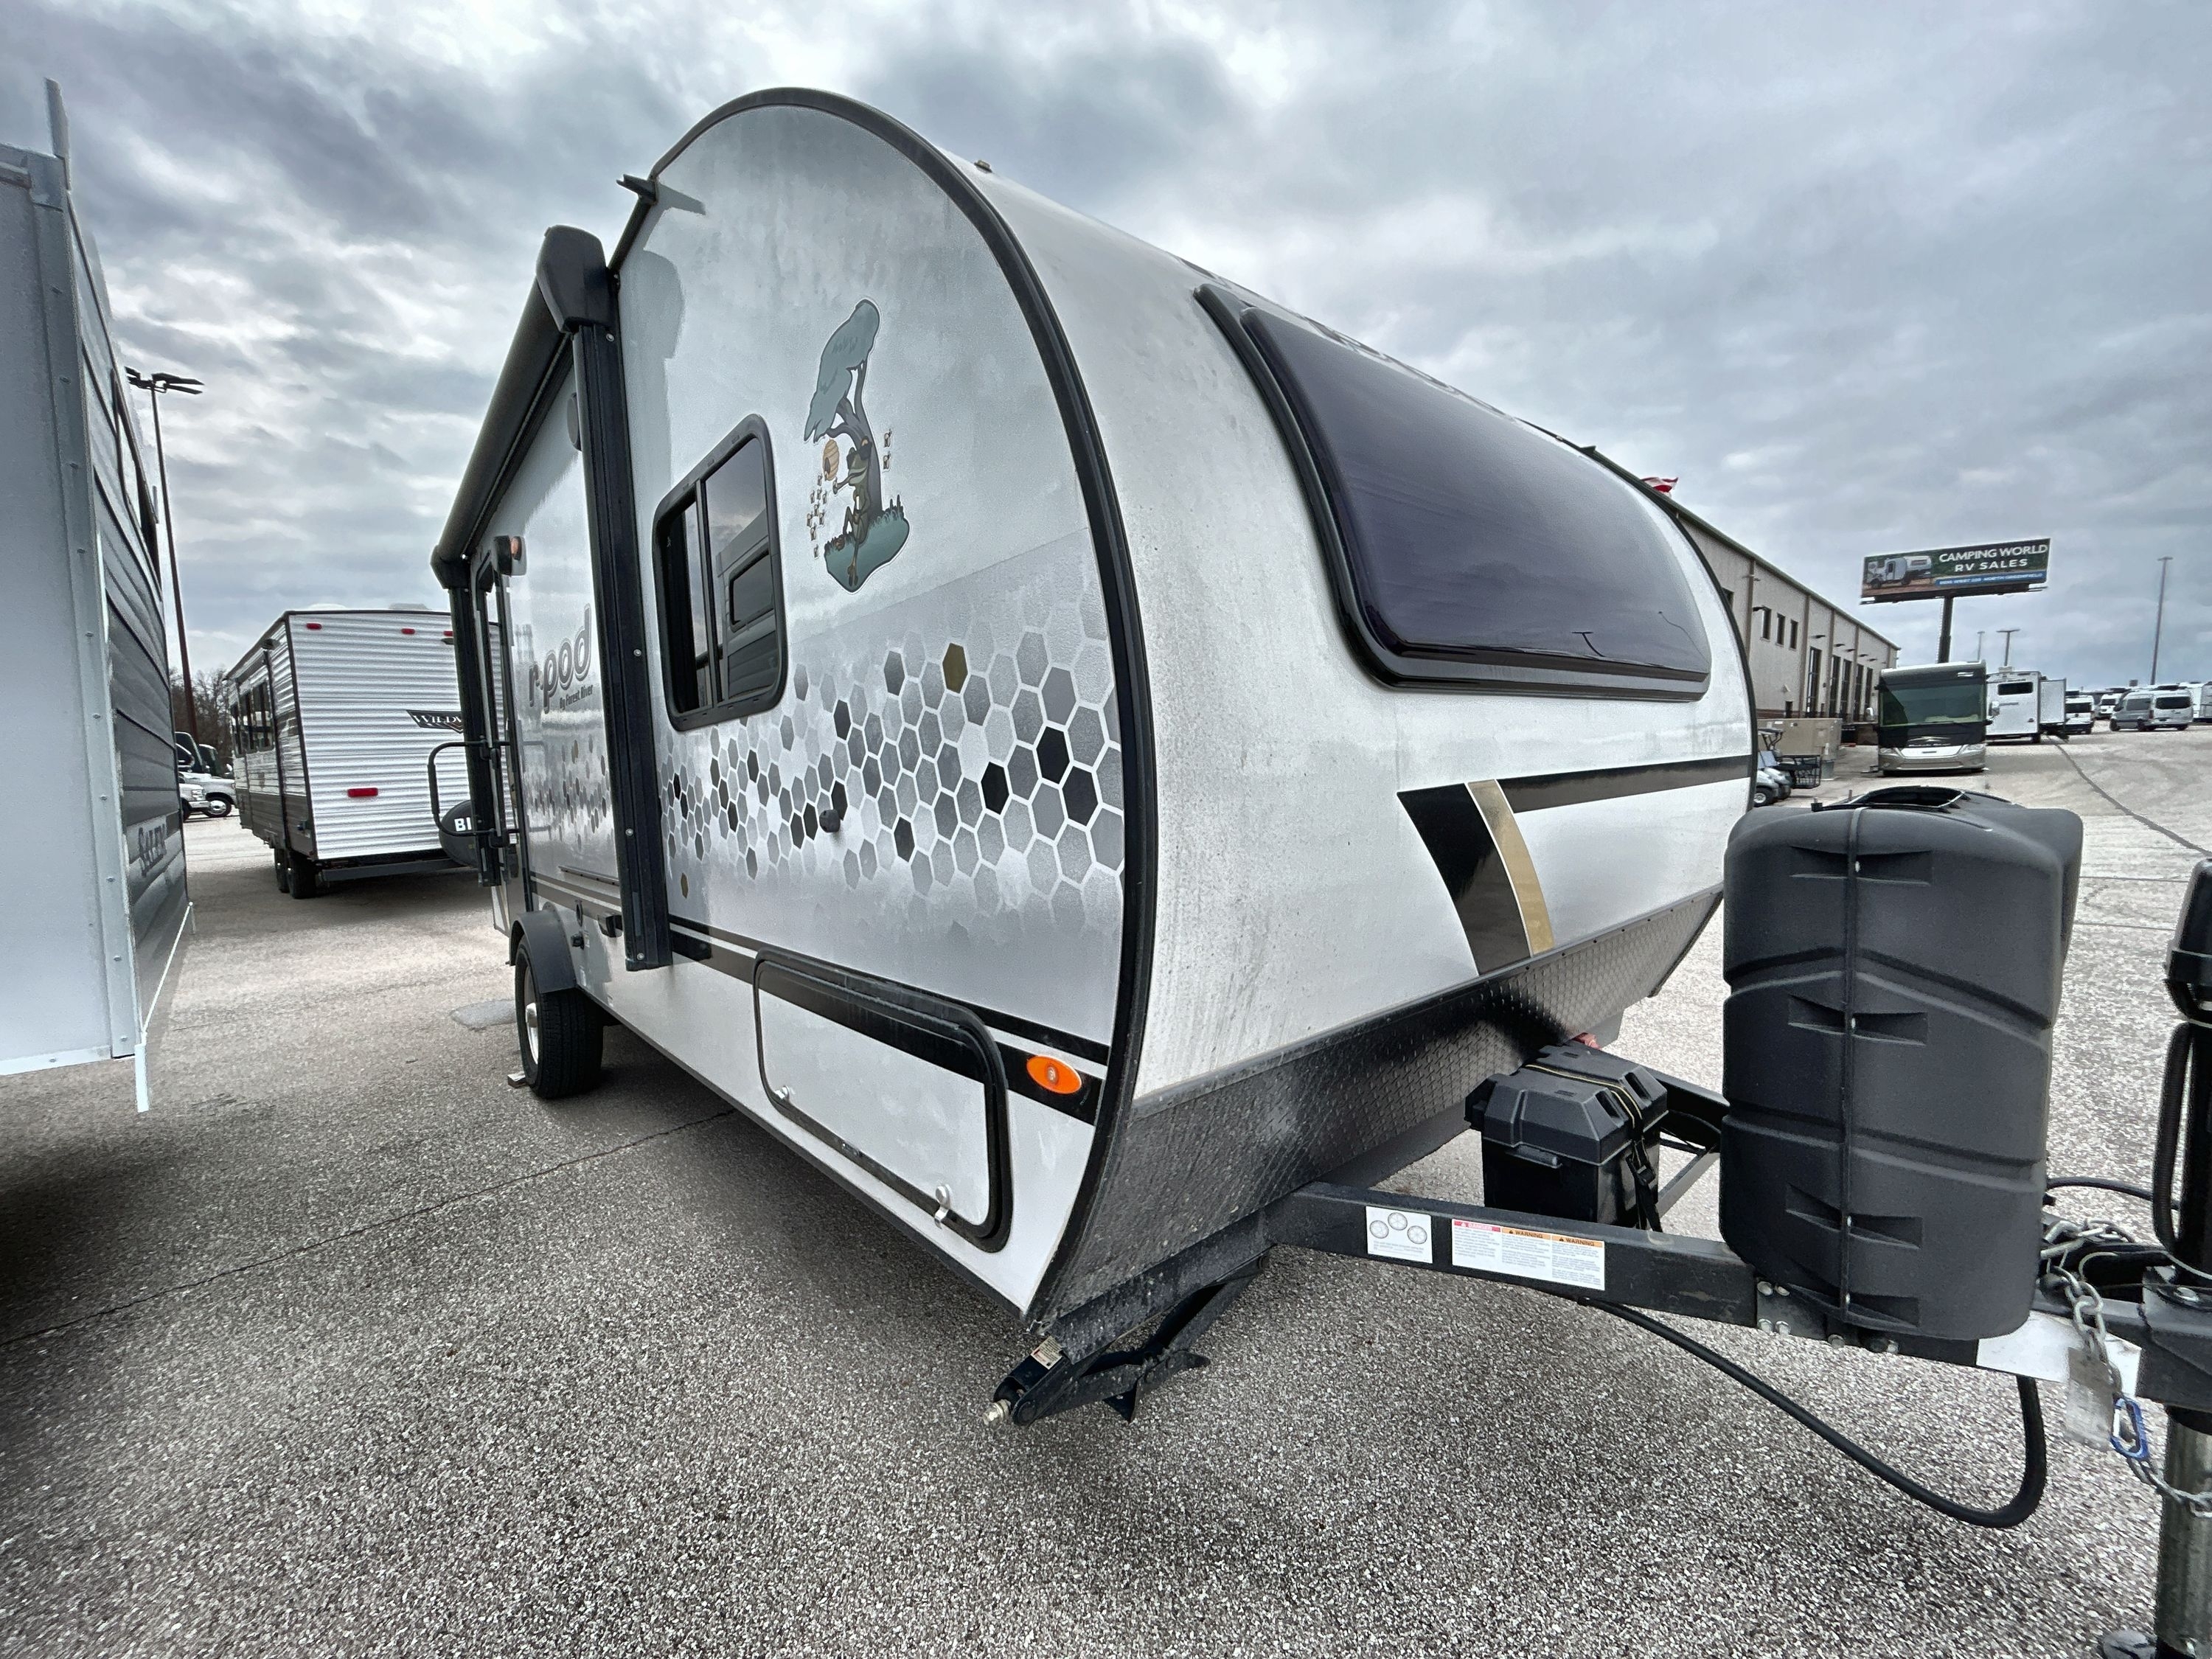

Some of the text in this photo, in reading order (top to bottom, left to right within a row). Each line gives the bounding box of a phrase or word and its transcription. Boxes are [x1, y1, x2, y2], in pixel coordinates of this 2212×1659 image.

[1939, 544, 2048, 563] CAMPING WORLD
[1955, 558, 2028, 572] RV SALES
[454, 817, 472, 832] BI
[1468, 1222, 1492, 1231] DANGER
[1515, 1230, 1543, 1239] WARNING
[1565, 1238, 1595, 1247] WARNING
